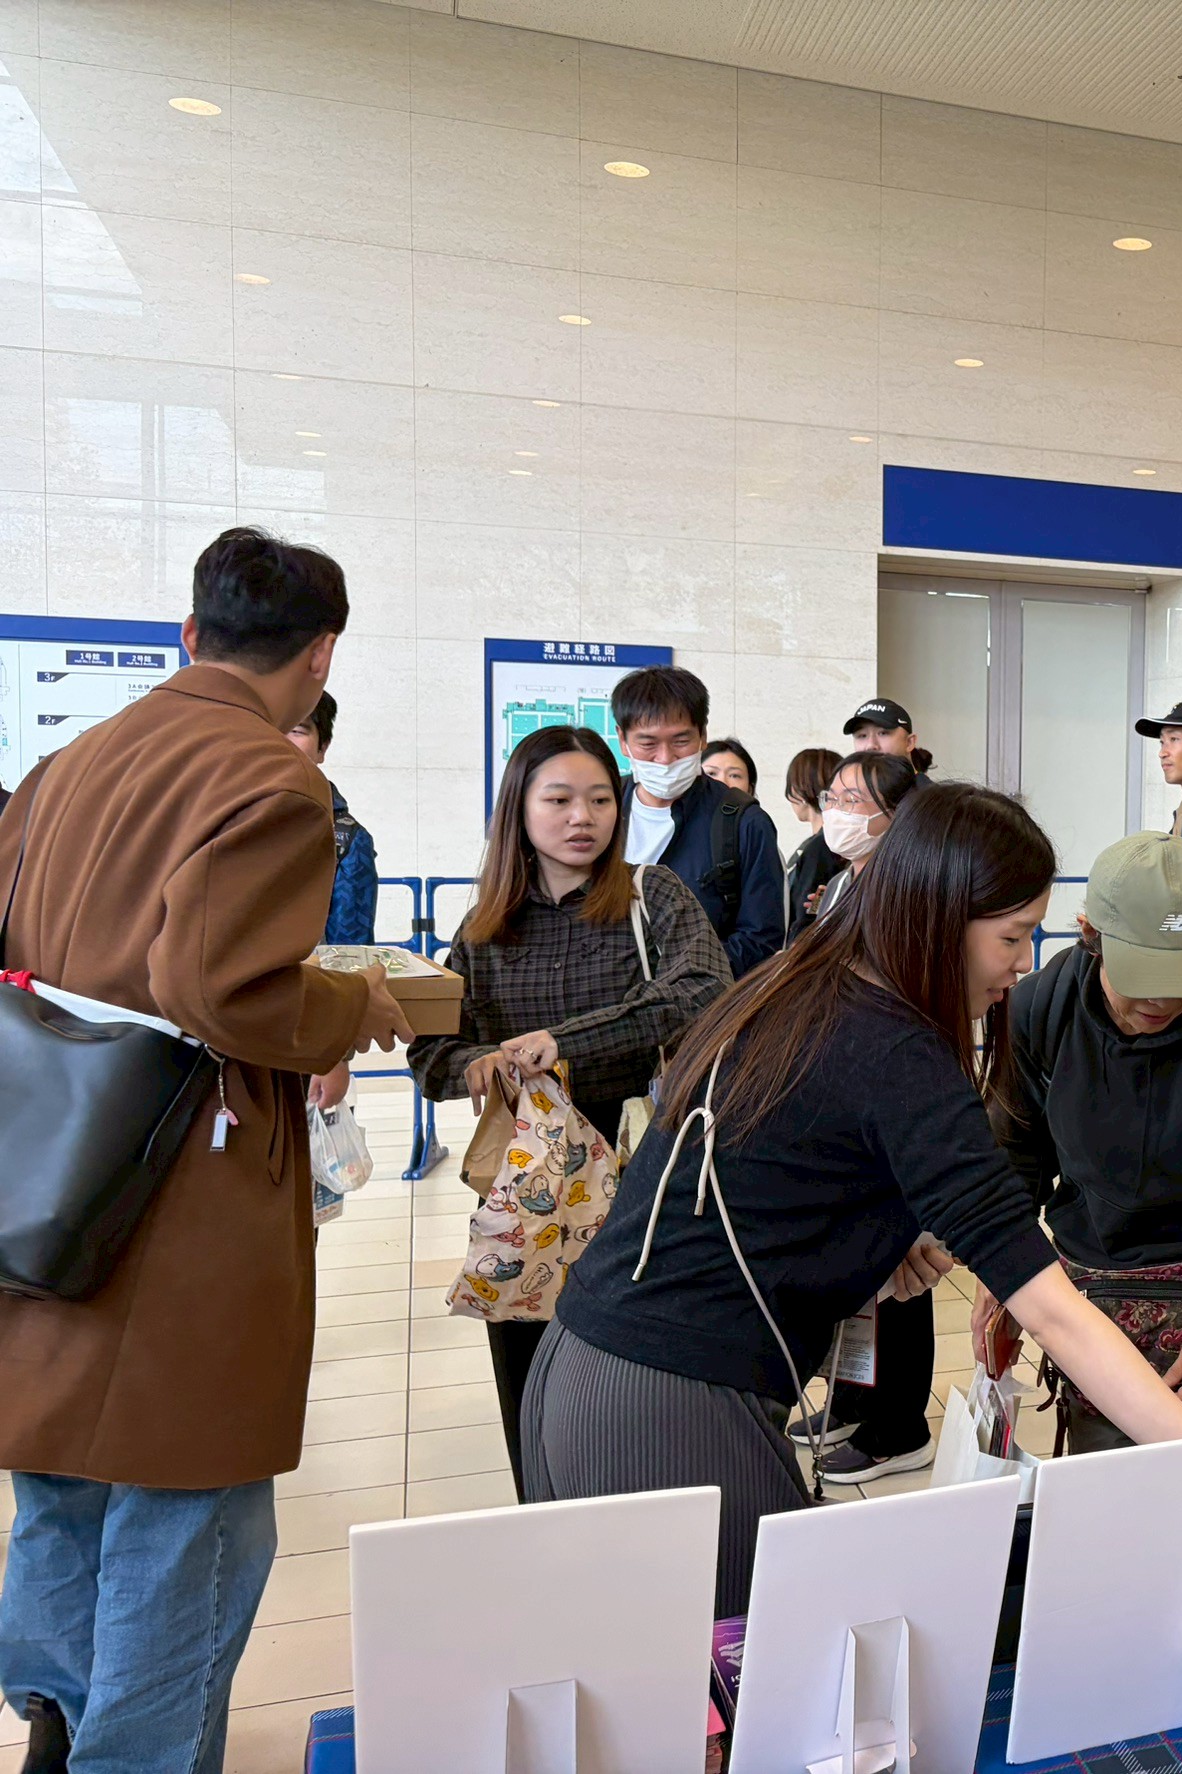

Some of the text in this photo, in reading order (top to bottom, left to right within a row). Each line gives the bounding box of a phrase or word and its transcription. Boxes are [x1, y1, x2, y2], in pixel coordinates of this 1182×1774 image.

[543, 642, 615, 656] 避難経路図
[543, 653, 616, 663] EVACUATION ROUTE
[857, 703, 886, 715] JAPAN
